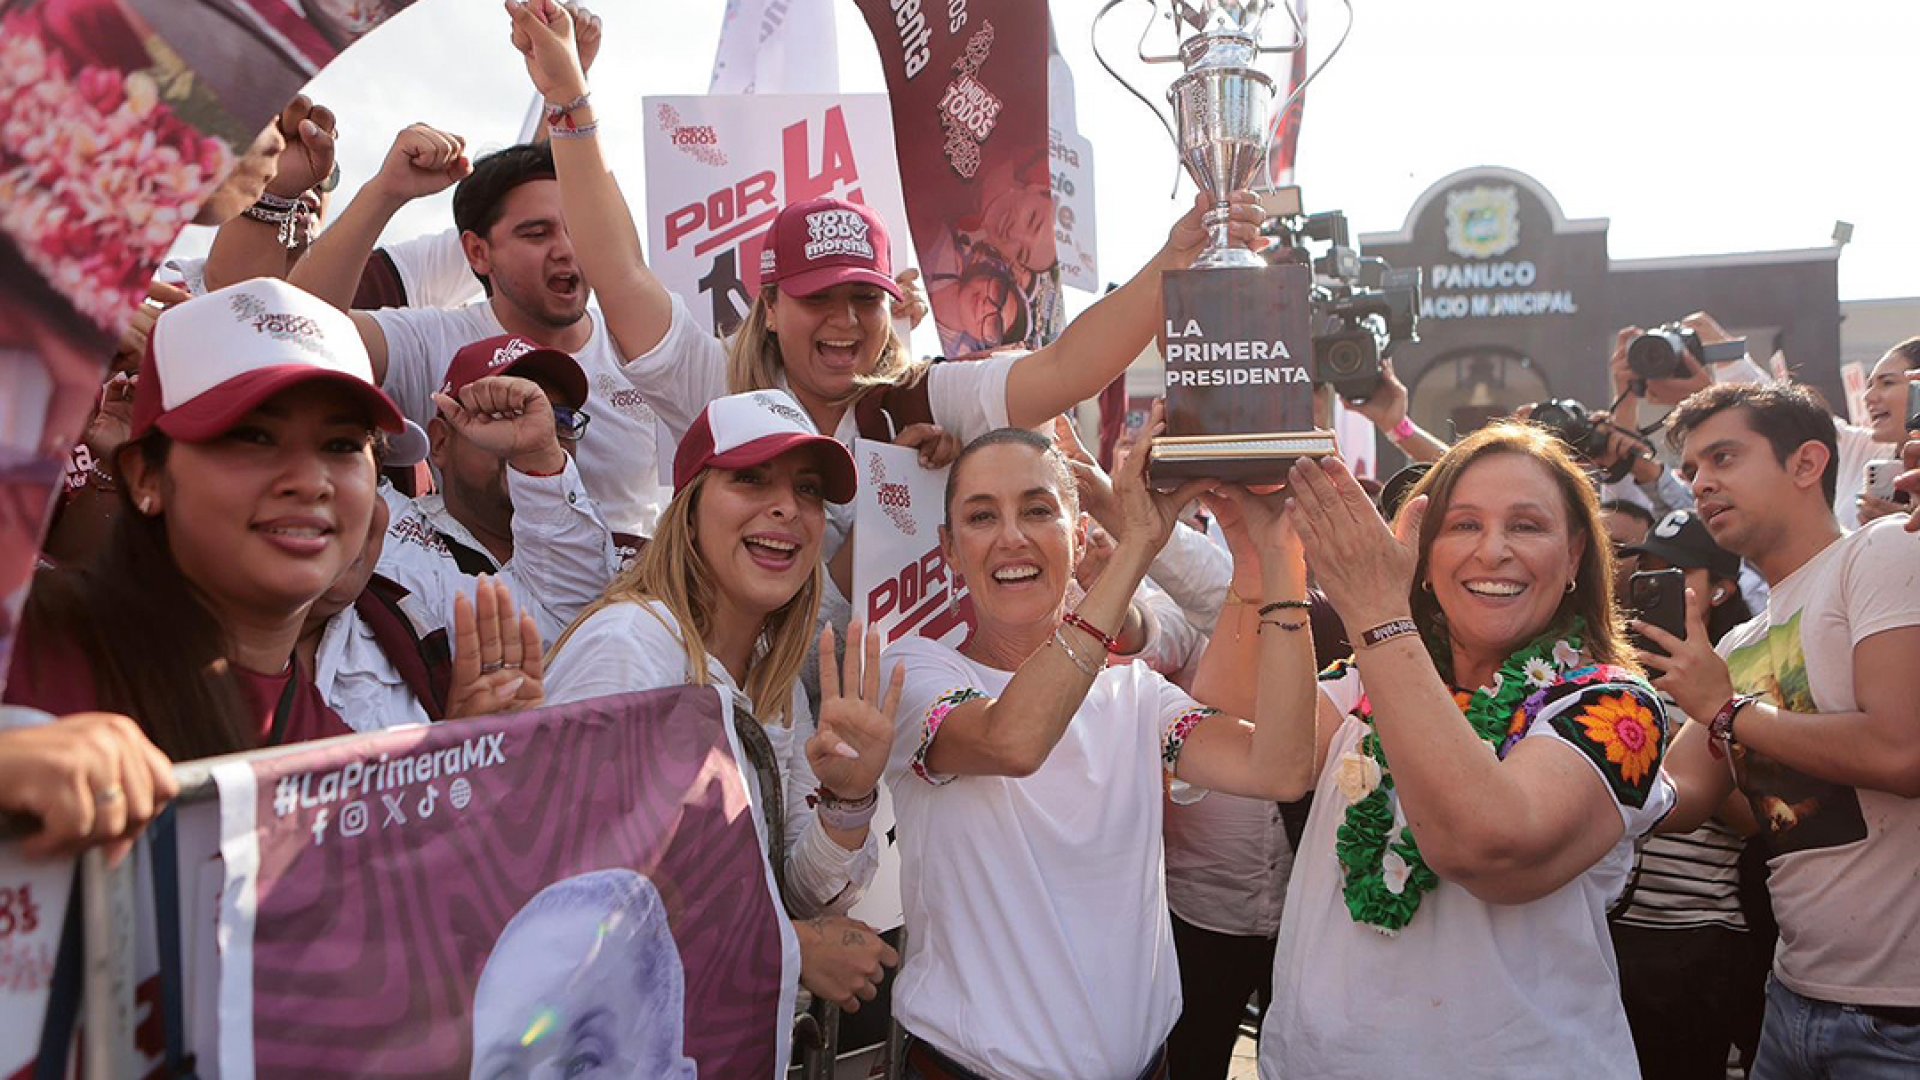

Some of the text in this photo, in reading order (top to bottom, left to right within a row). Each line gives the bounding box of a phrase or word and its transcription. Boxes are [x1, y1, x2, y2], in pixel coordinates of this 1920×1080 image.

[948, 0, 968, 33] OS
[941, 86, 993, 138] TODOS
[671, 134, 717, 145] TODOS
[665, 104, 859, 251] POR LA
[805, 240, 873, 260] morena
[1432, 261, 1536, 289] PANUCO
[1166, 319, 1203, 338] LA
[1167, 340, 1290, 363] PRIMERA
[1167, 367, 1311, 387] PRESIDENTA
[877, 491, 911, 509] TODOS
[867, 545, 948, 627] POR
[273, 731, 506, 817] #LaPrimeraMX
